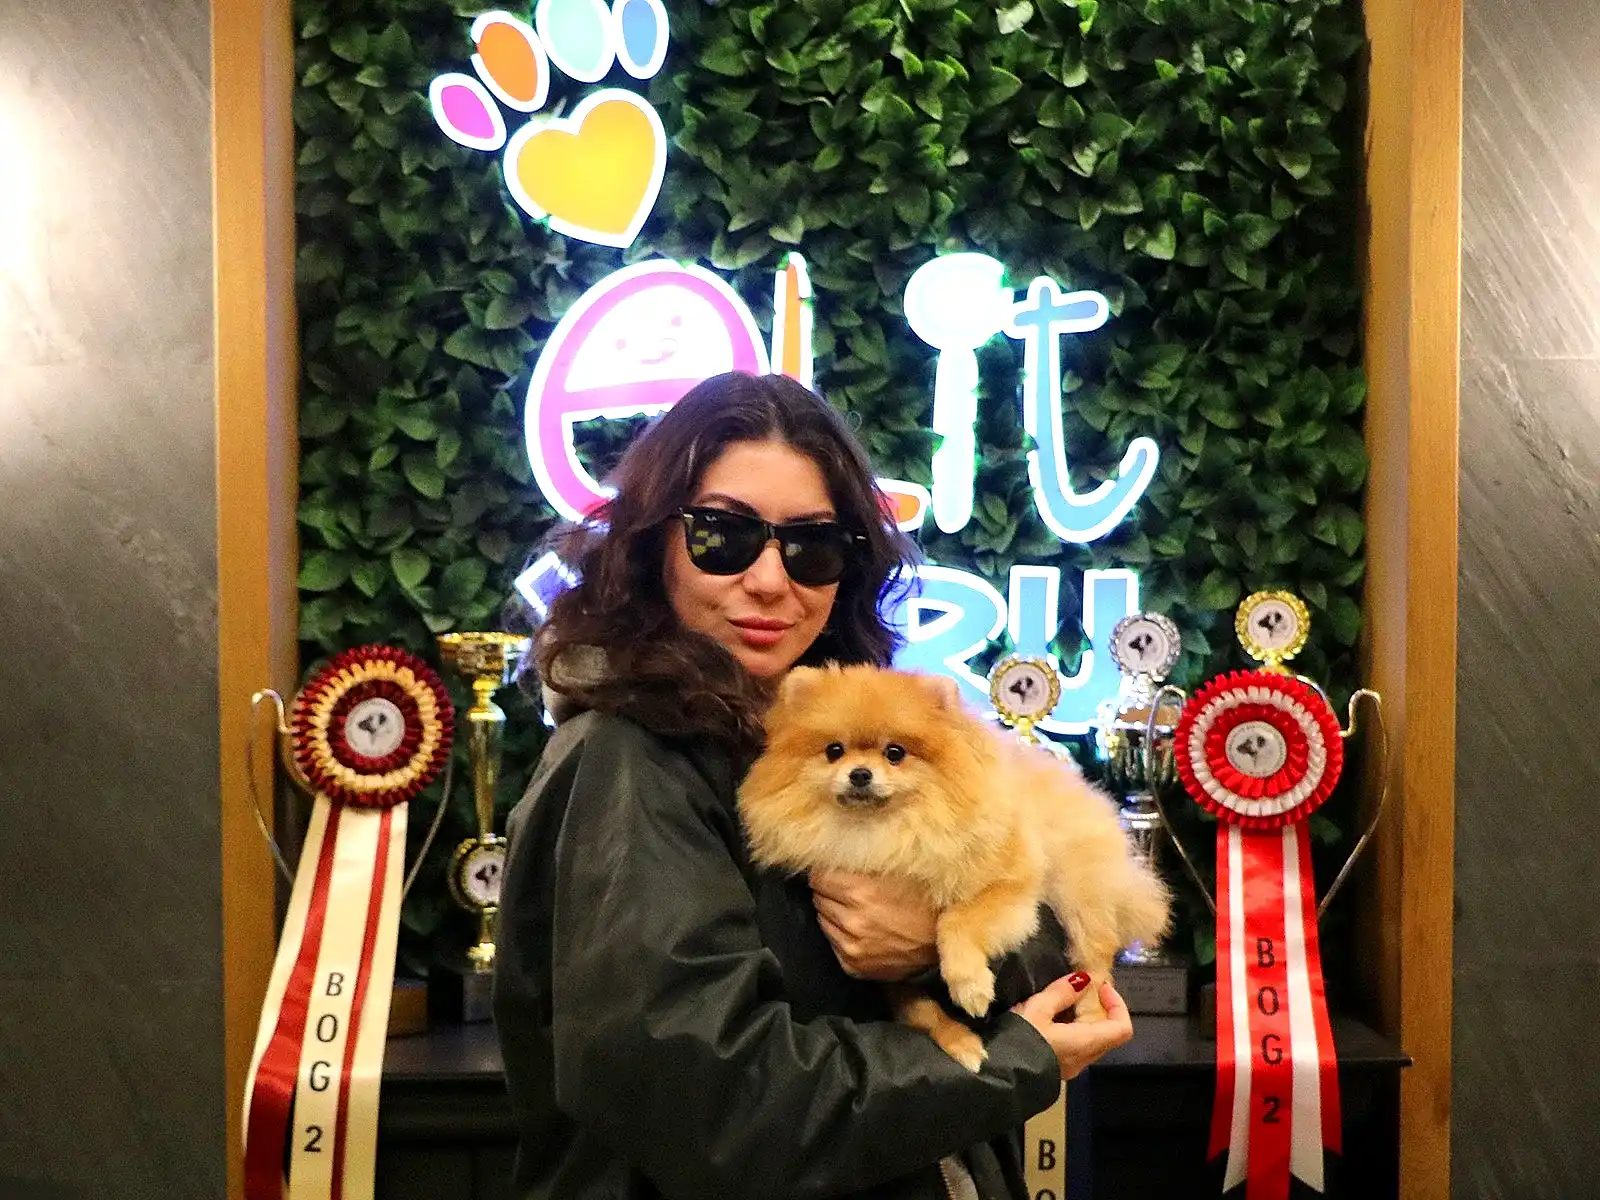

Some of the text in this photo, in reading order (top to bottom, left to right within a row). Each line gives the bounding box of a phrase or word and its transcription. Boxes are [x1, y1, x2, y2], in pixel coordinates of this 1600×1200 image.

[303, 971, 345, 1153] BOG 2
[1256, 937, 1283, 1124] BOG 2
